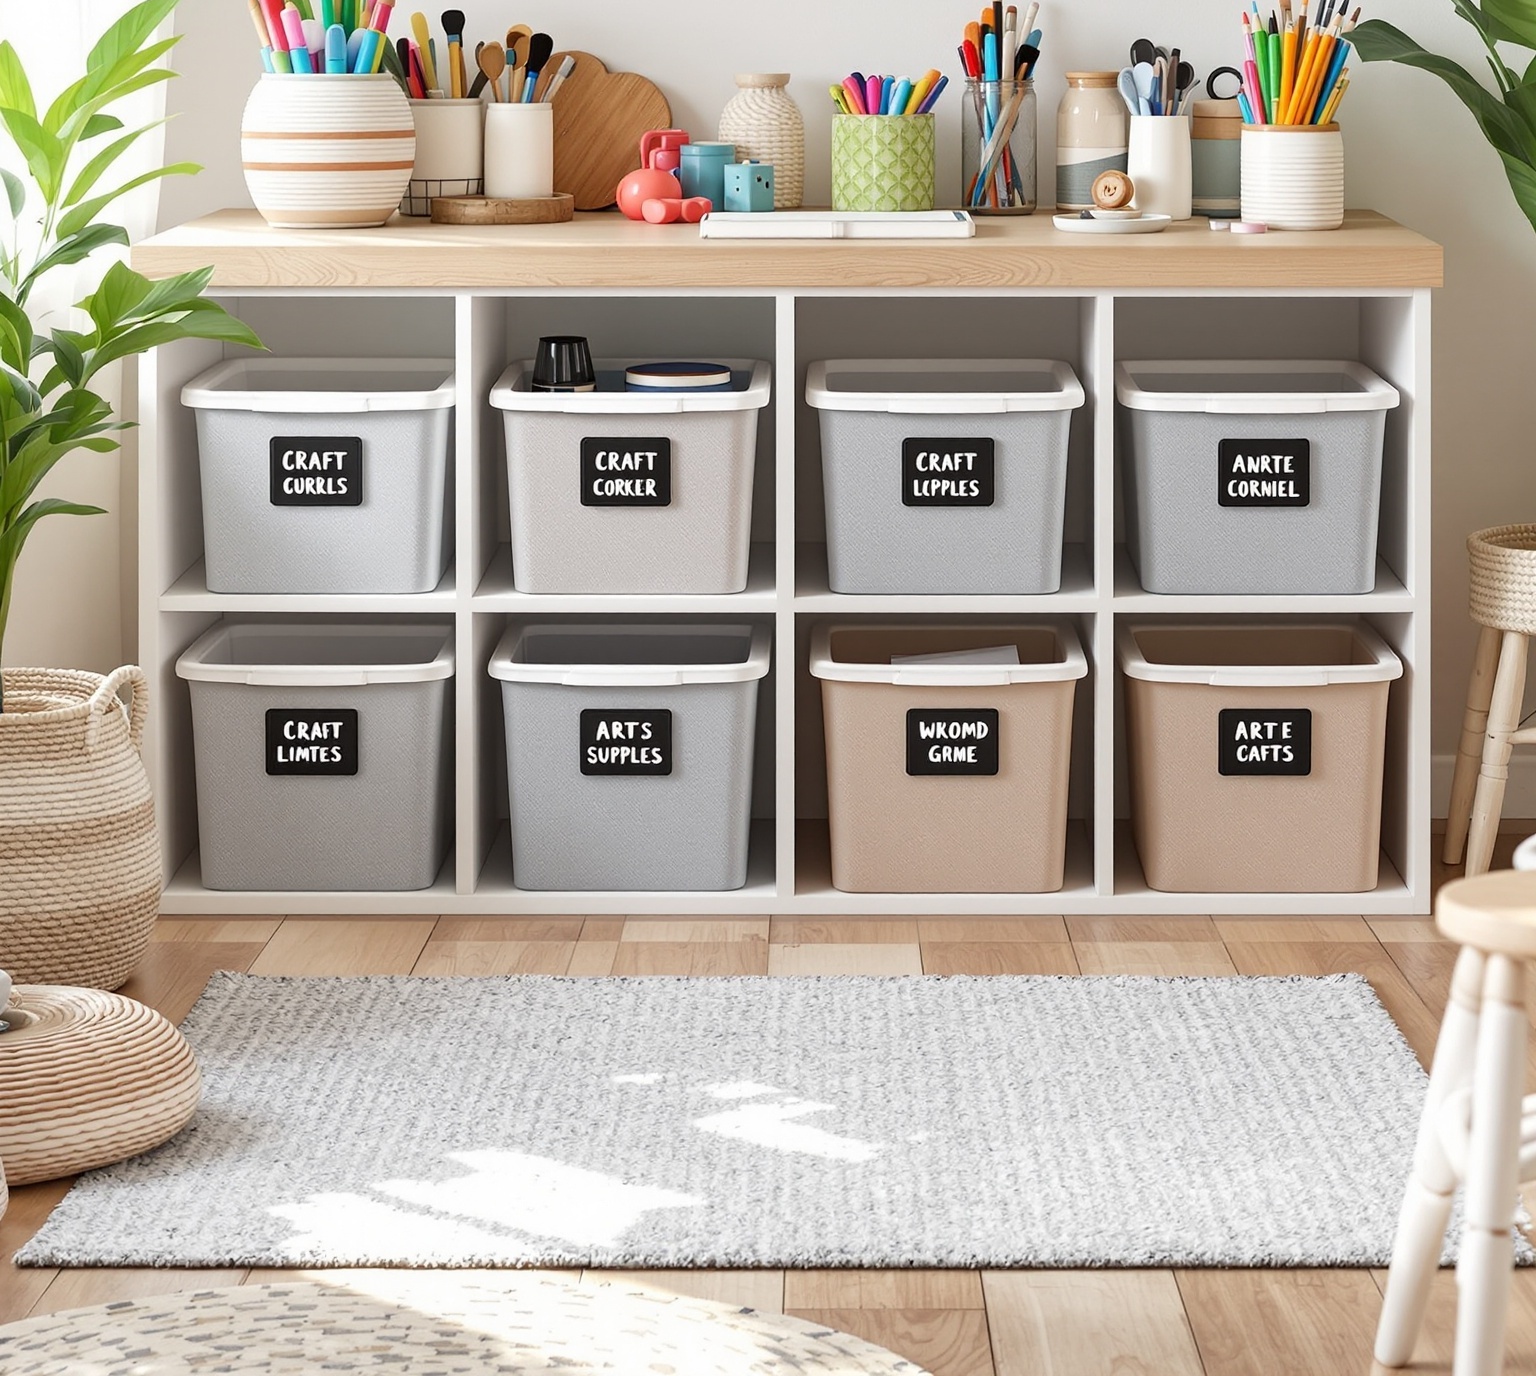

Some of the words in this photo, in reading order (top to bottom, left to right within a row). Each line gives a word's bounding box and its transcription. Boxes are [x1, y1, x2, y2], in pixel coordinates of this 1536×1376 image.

[281, 449, 348, 471] CRAFT
[594, 451, 658, 472] CRAFT
[915, 451, 978, 473] CRAFT
[1232, 454, 1295, 474] ANRTE
[283, 720, 344, 742] CRAFT
[595, 720, 653, 741] ARTS
[587, 746, 663, 765] SUPPLES
[1236, 744, 1294, 763] CAFTS
